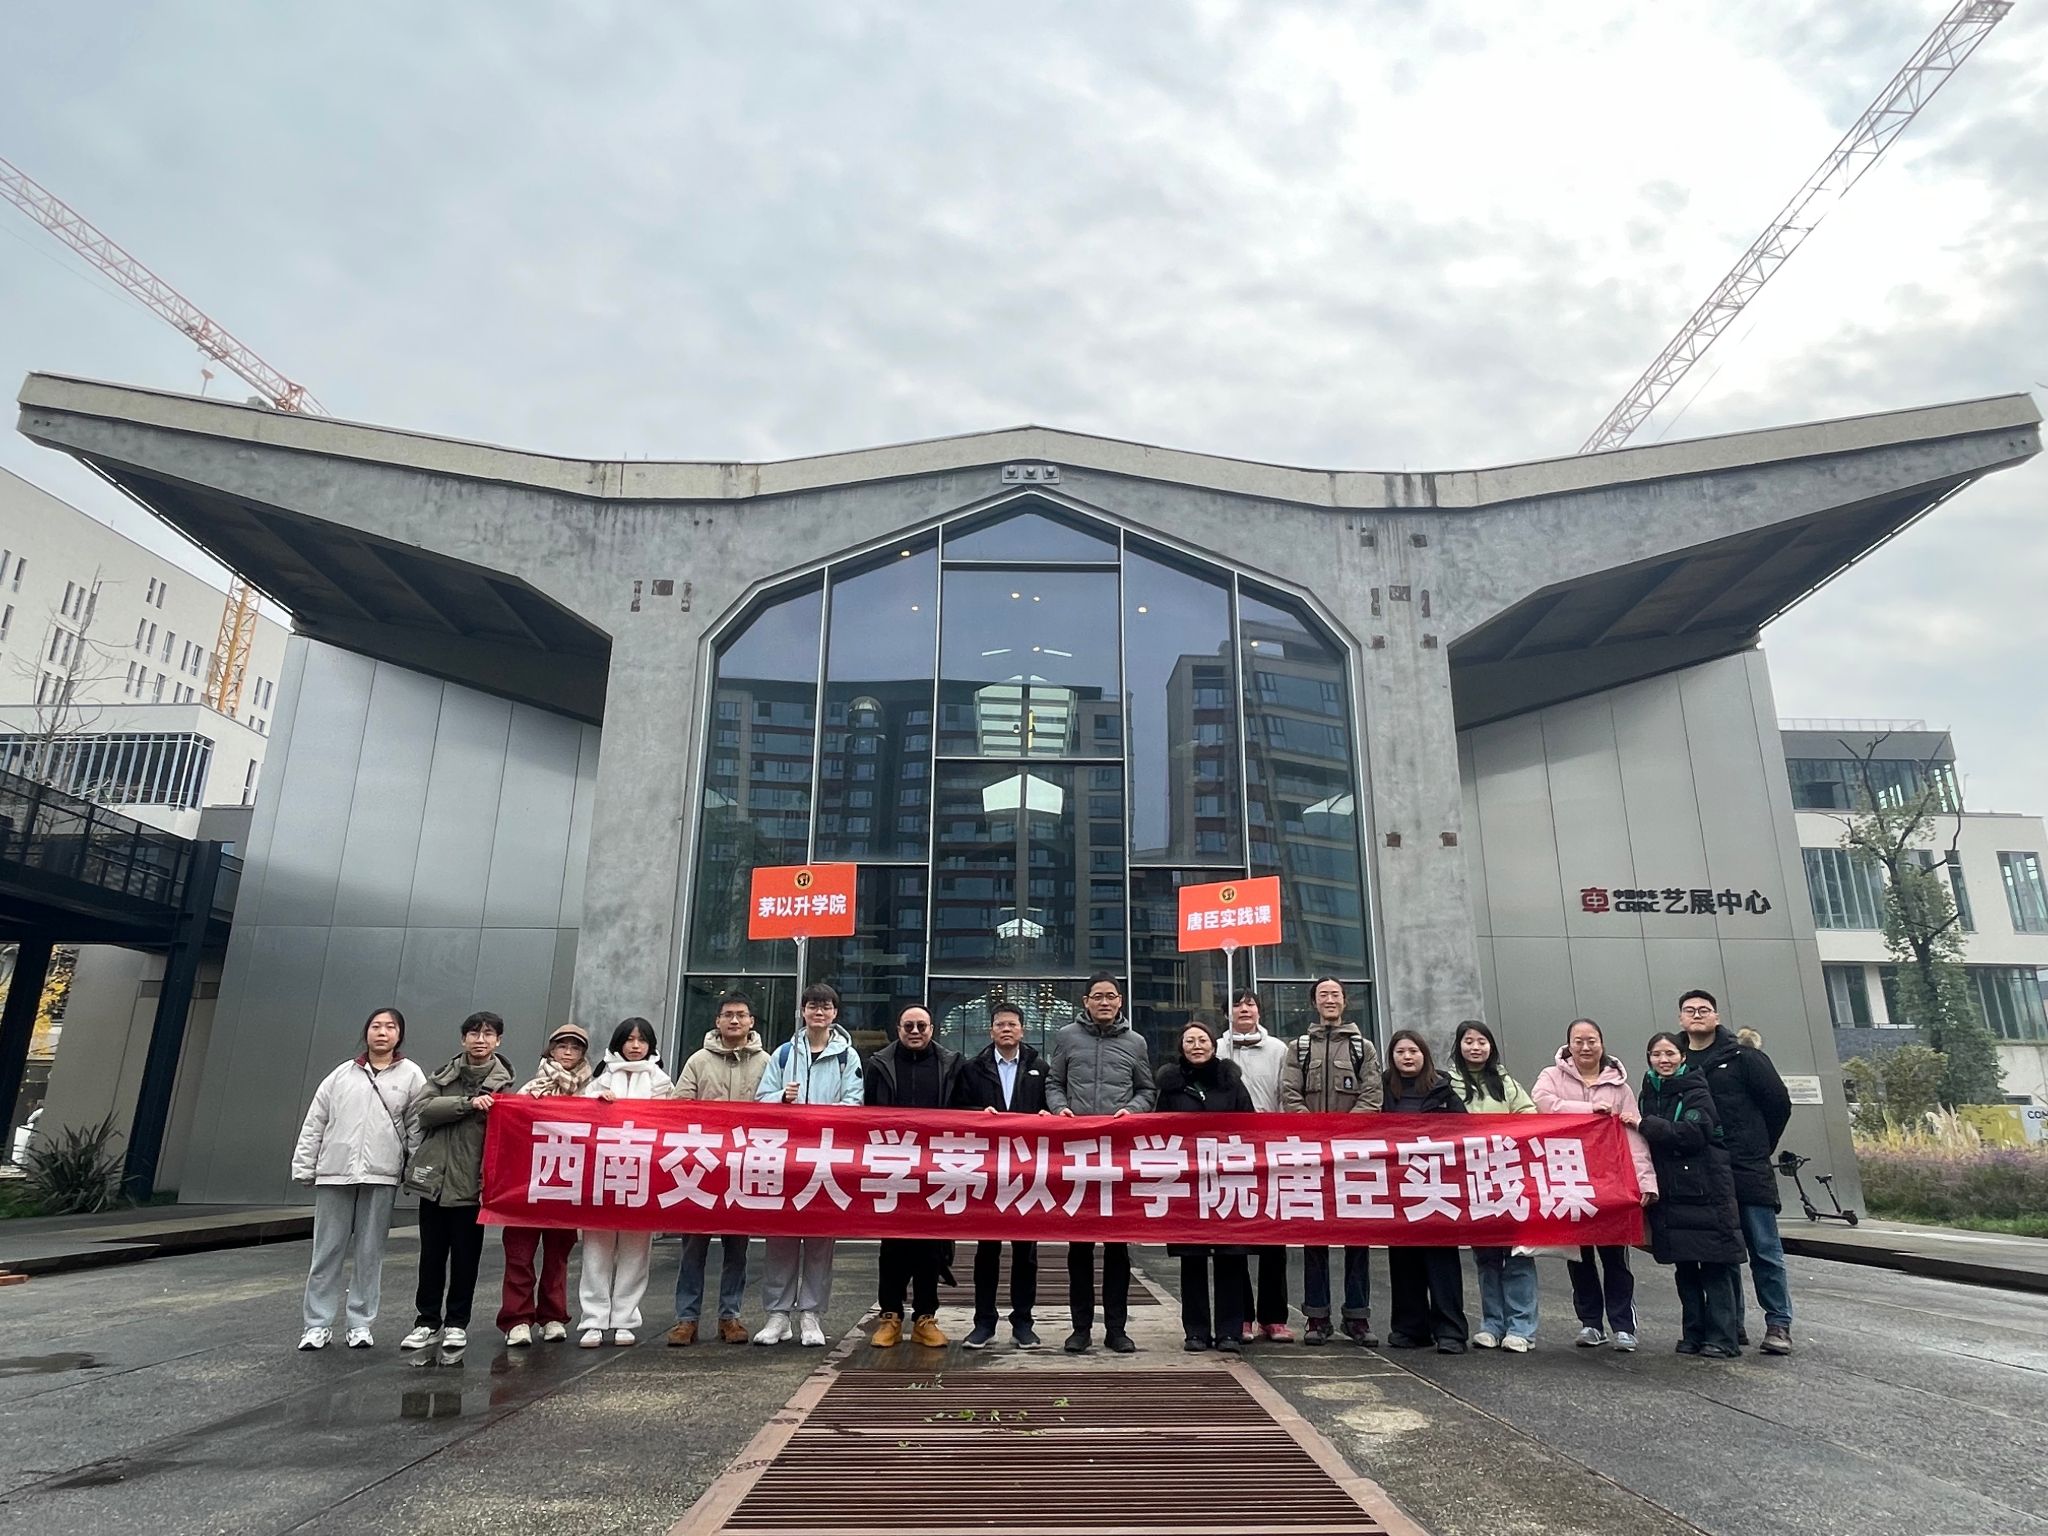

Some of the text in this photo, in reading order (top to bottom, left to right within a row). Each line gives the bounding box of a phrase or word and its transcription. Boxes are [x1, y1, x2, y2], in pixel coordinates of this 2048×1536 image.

[758, 894, 847, 918] 茅以升学院
[1615, 901, 1661, 912] CRRC
[1661, 888, 1772, 915] 艺展中心
[1187, 905, 1272, 931] 唐臣实践课
[527, 1120, 1599, 1222] 西南交通大学茅以升学院唐臣实践课
